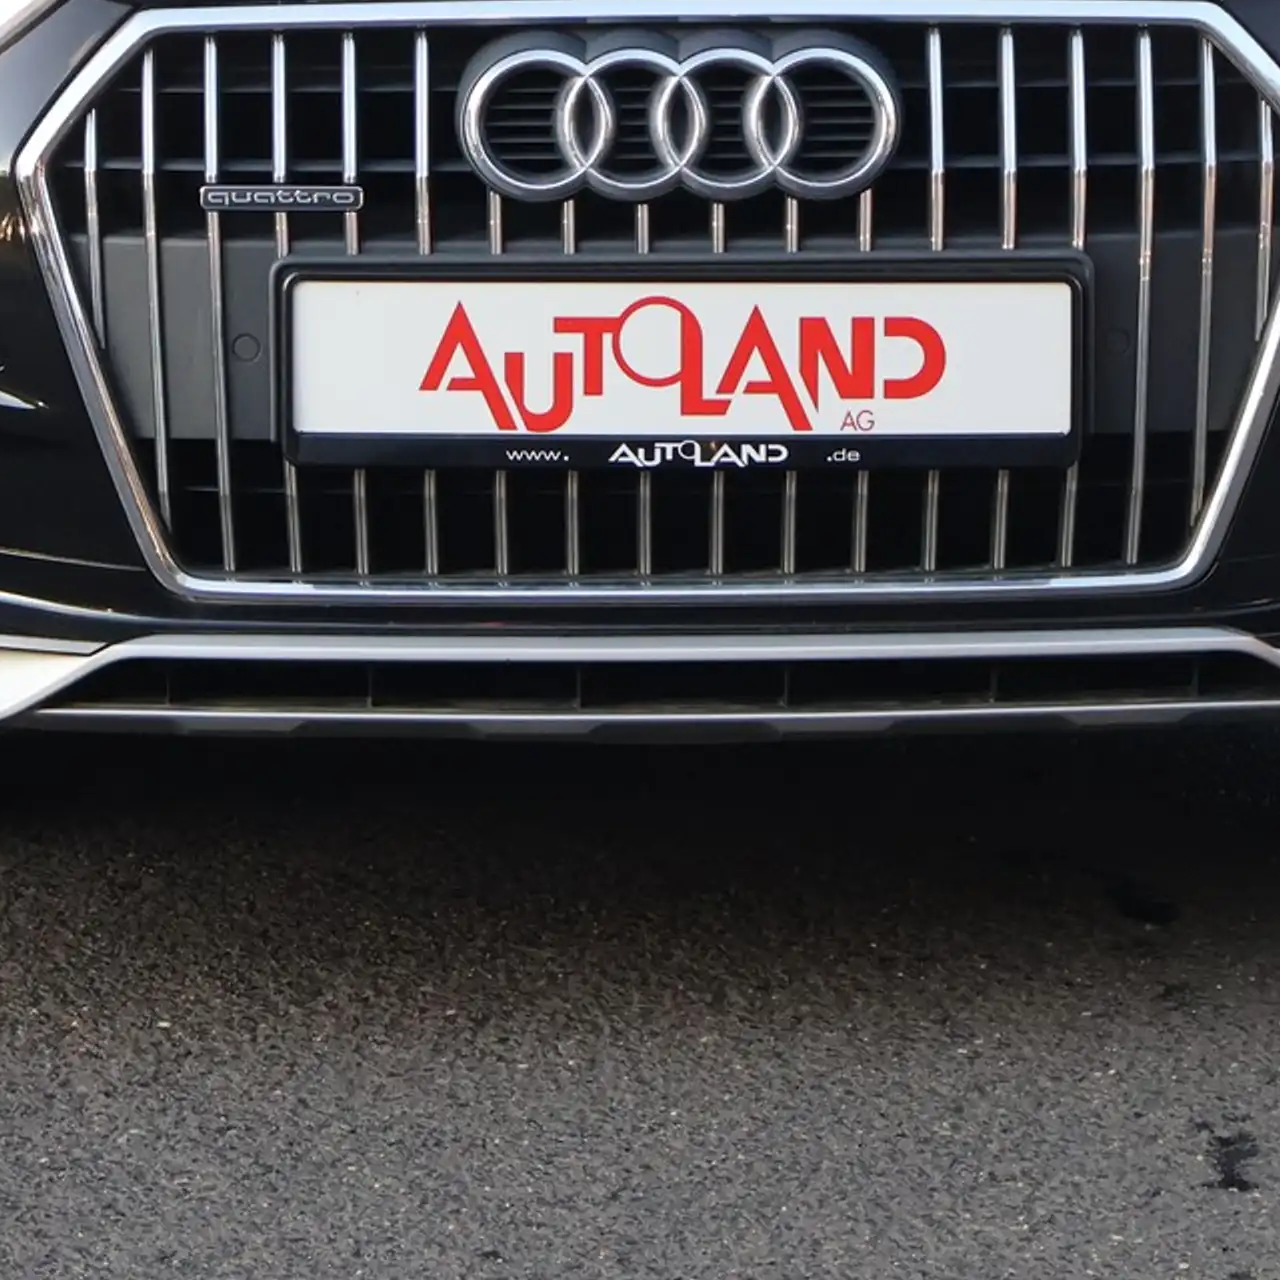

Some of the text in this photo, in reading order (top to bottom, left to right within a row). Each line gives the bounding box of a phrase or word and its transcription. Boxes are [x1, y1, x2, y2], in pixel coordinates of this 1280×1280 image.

[207, 190, 355, 206] quattro
[420, 296, 947, 432] AUTOLAND
[841, 410, 875, 432] AG
[505, 440, 861, 467] www. AUTOLAND .de
